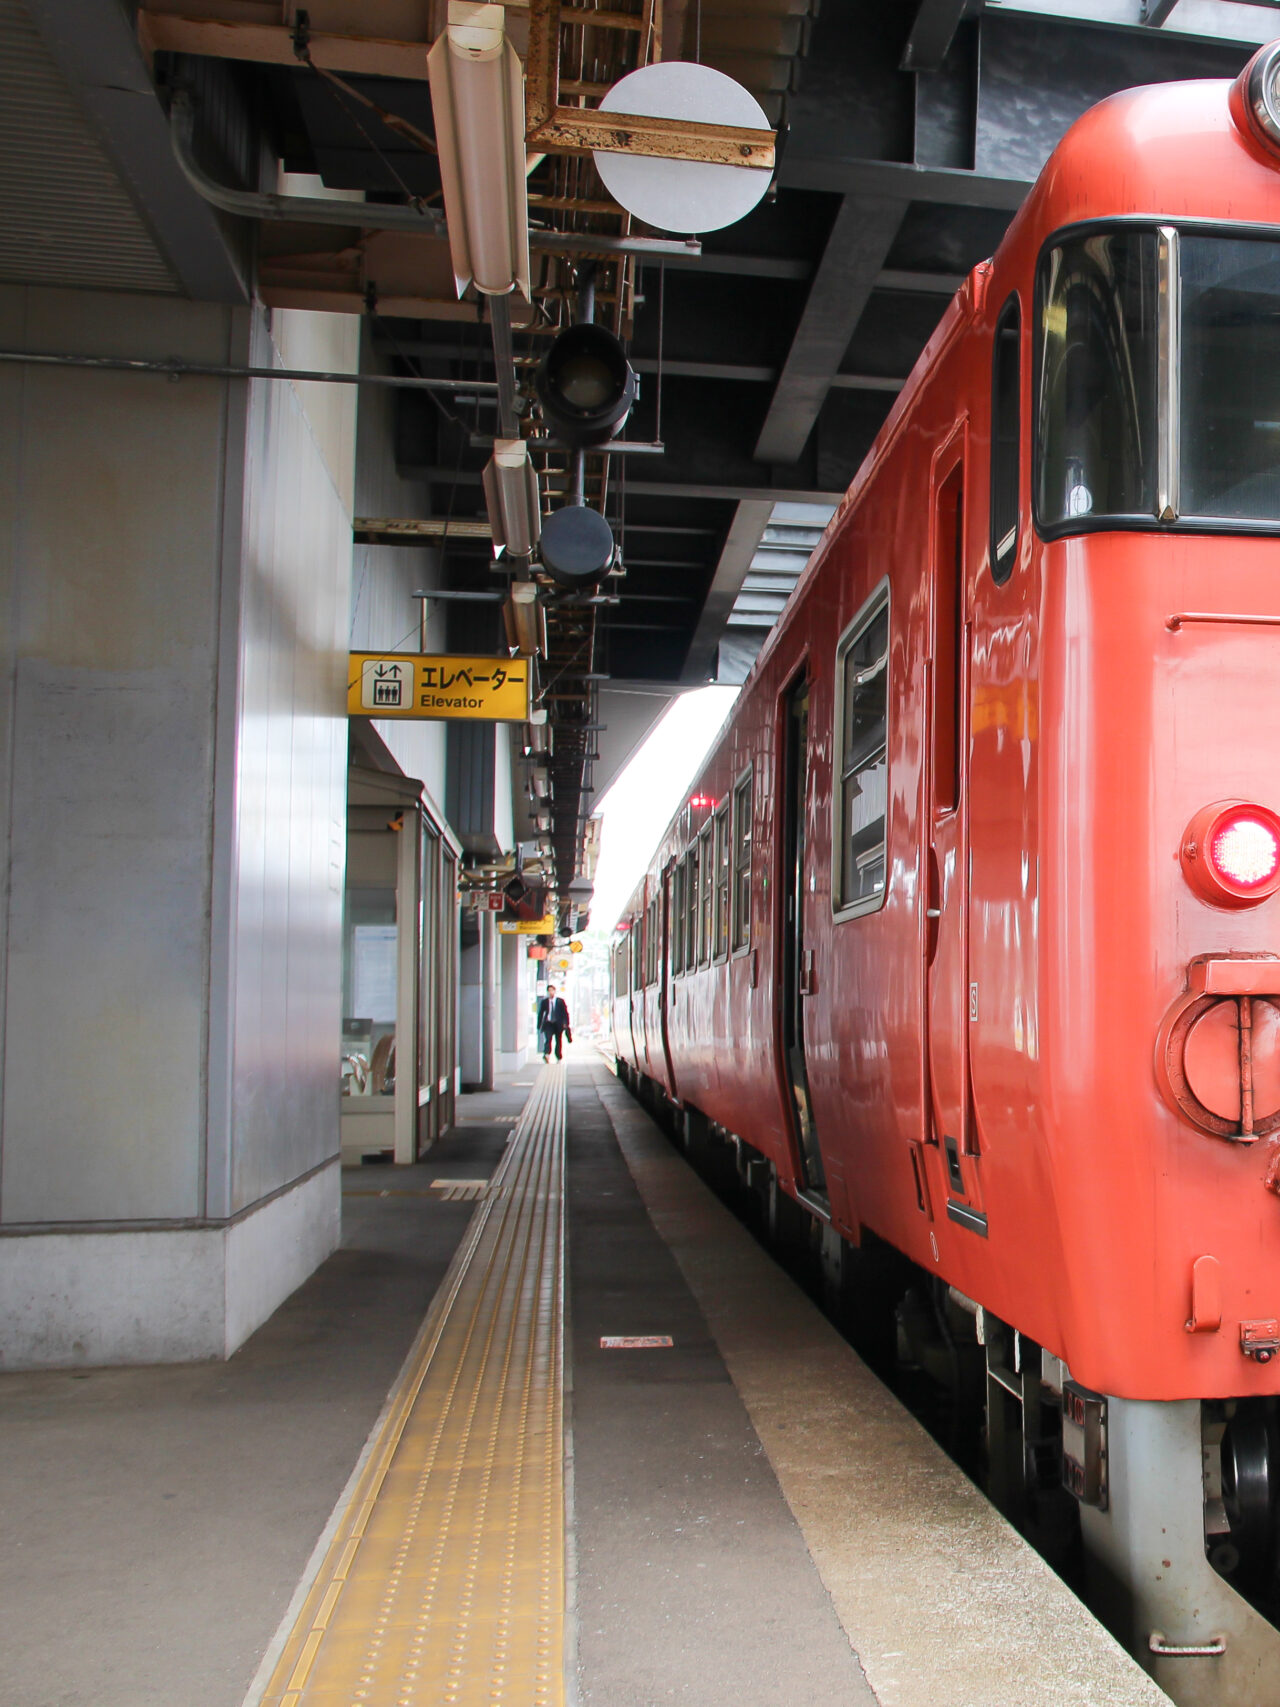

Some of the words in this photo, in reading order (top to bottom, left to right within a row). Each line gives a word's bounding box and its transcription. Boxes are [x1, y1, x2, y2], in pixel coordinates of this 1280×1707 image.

[421, 666, 525, 691] エレベーター
[420, 694, 484, 709] Elevator
